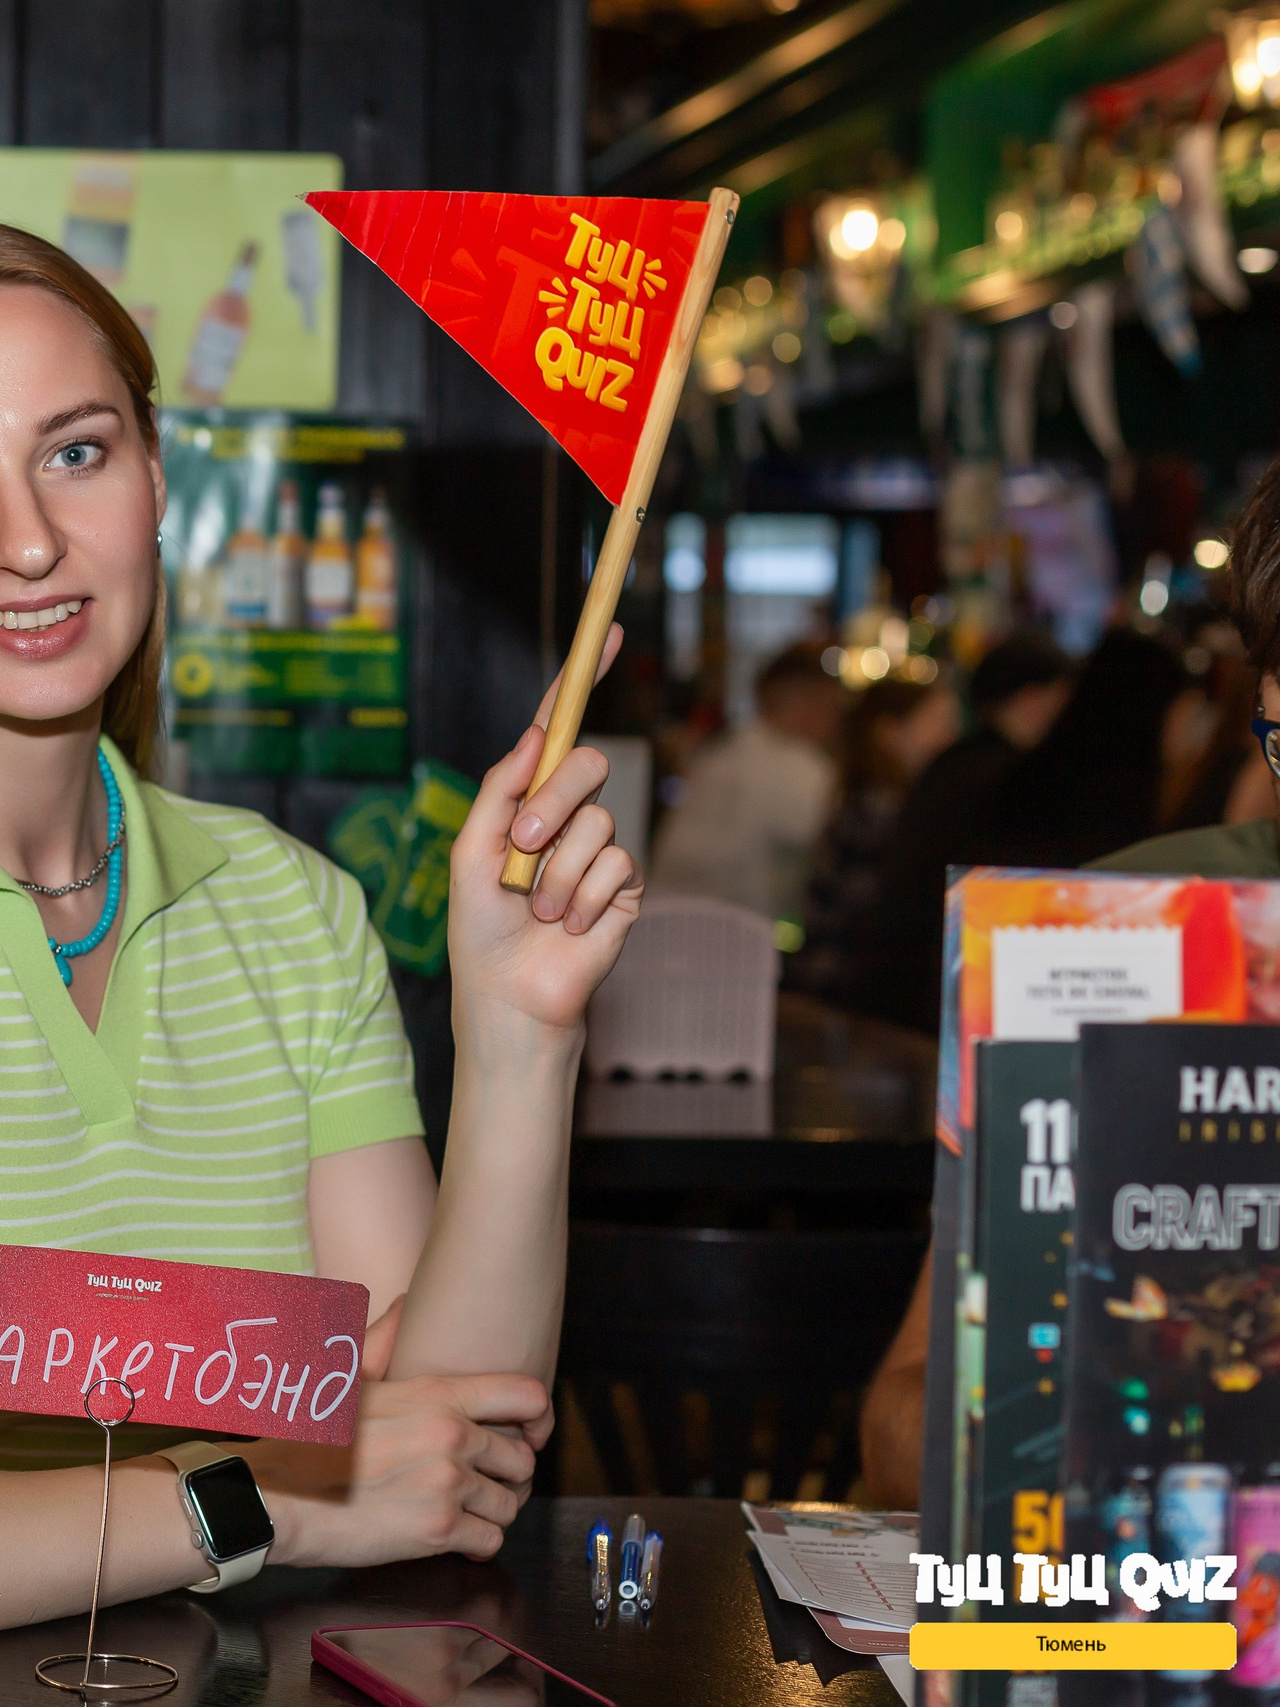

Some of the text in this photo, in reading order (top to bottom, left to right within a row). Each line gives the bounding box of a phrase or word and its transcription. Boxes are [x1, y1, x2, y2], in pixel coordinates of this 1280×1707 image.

[1179, 1066, 1280, 1113] HAR
[1020, 1098, 1078, 1163] 11
[1020, 1164, 1076, 1212] ПА
[1113, 1183, 1280, 1251] CRAFT
